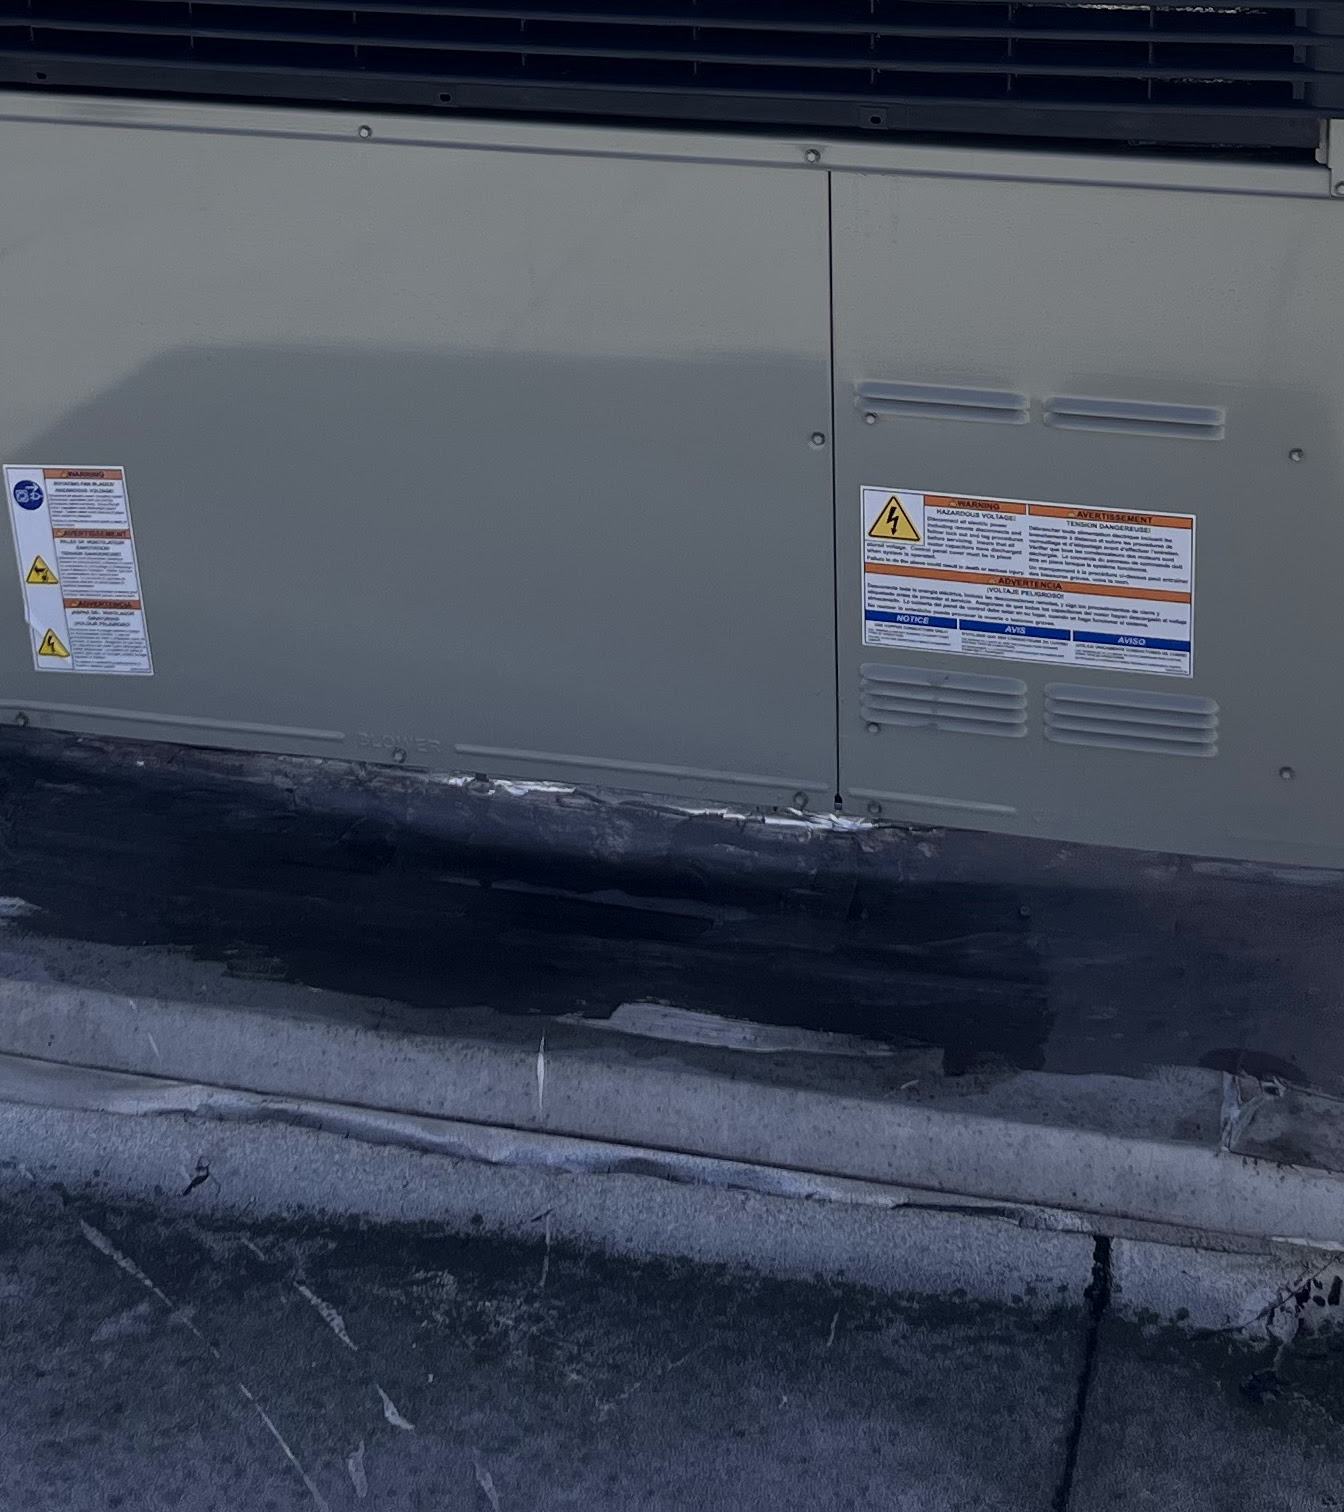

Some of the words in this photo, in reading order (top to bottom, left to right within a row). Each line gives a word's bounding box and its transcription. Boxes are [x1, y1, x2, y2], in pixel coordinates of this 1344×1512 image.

[957, 500, 1000, 510] WARNING
[1076, 510, 1153, 524] AVERTISSEMENT
[997, 577, 1062, 589] ADVERTENCIA
[896, 614, 929, 624] NOTICE
[1004, 625, 1026, 634] AVIS
[1117, 636, 1146, 645] AVISO
